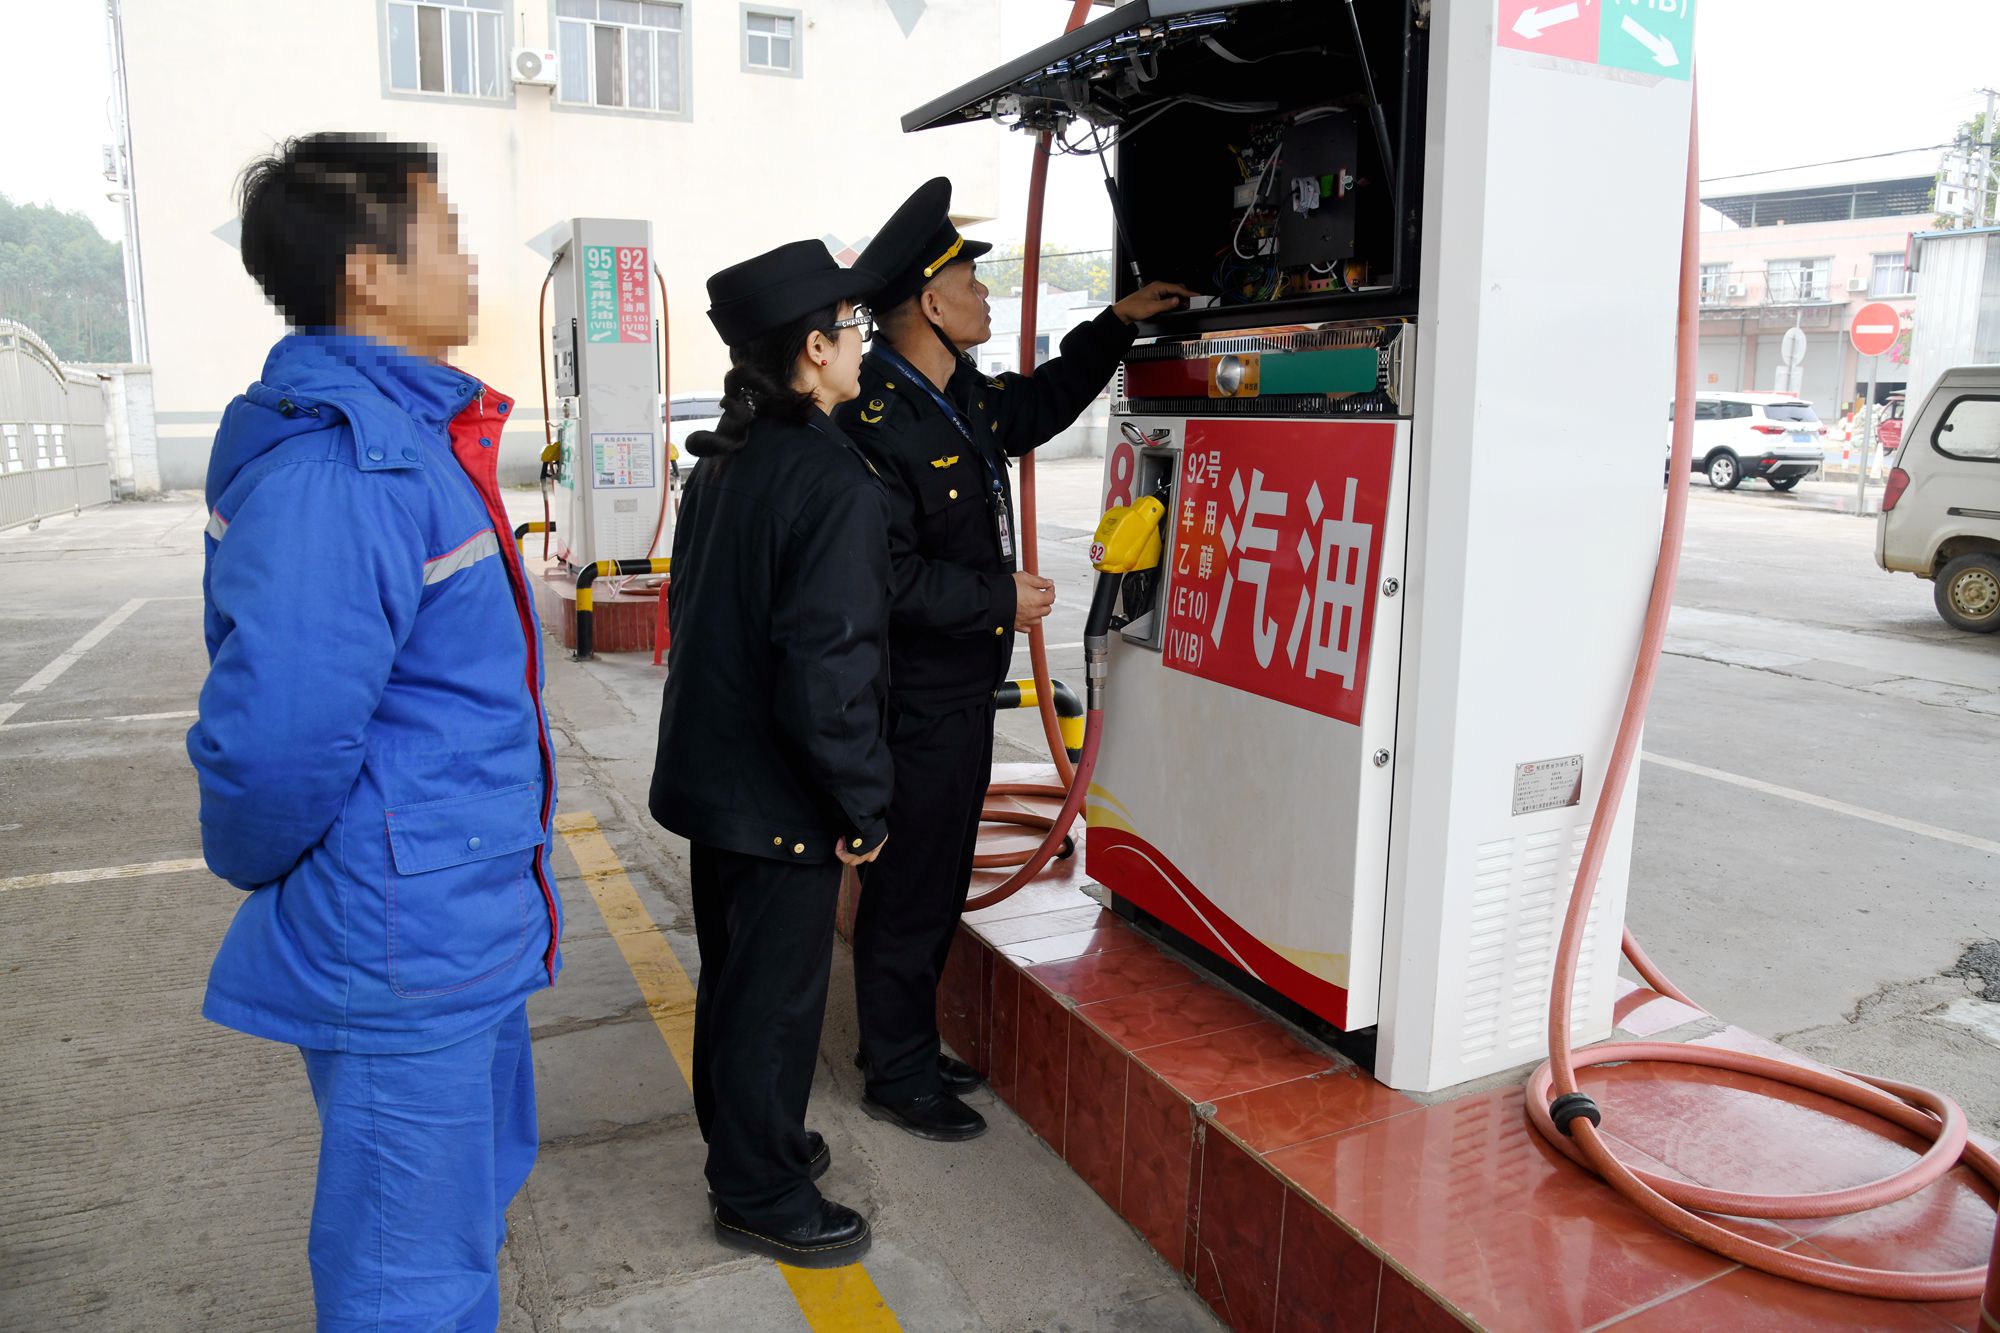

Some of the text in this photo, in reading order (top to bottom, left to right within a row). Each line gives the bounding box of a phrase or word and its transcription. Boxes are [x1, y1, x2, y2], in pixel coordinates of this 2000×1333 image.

[588, 248, 612, 269] 95
[620, 249, 644, 270] 92
[622, 315, 648, 323] (E10)
[842, 317, 868, 327] CHANEL
[1187, 450, 1222, 489] 92号
[1181, 497, 1217, 536] 车用
[1090, 545, 1104, 561] 92
[1178, 543, 1215, 580] 乙醇
[1211, 467, 1374, 691] 汽油
[1172, 586, 1208, 624] (E10)
[1168, 628, 1204, 668] (VIB)
